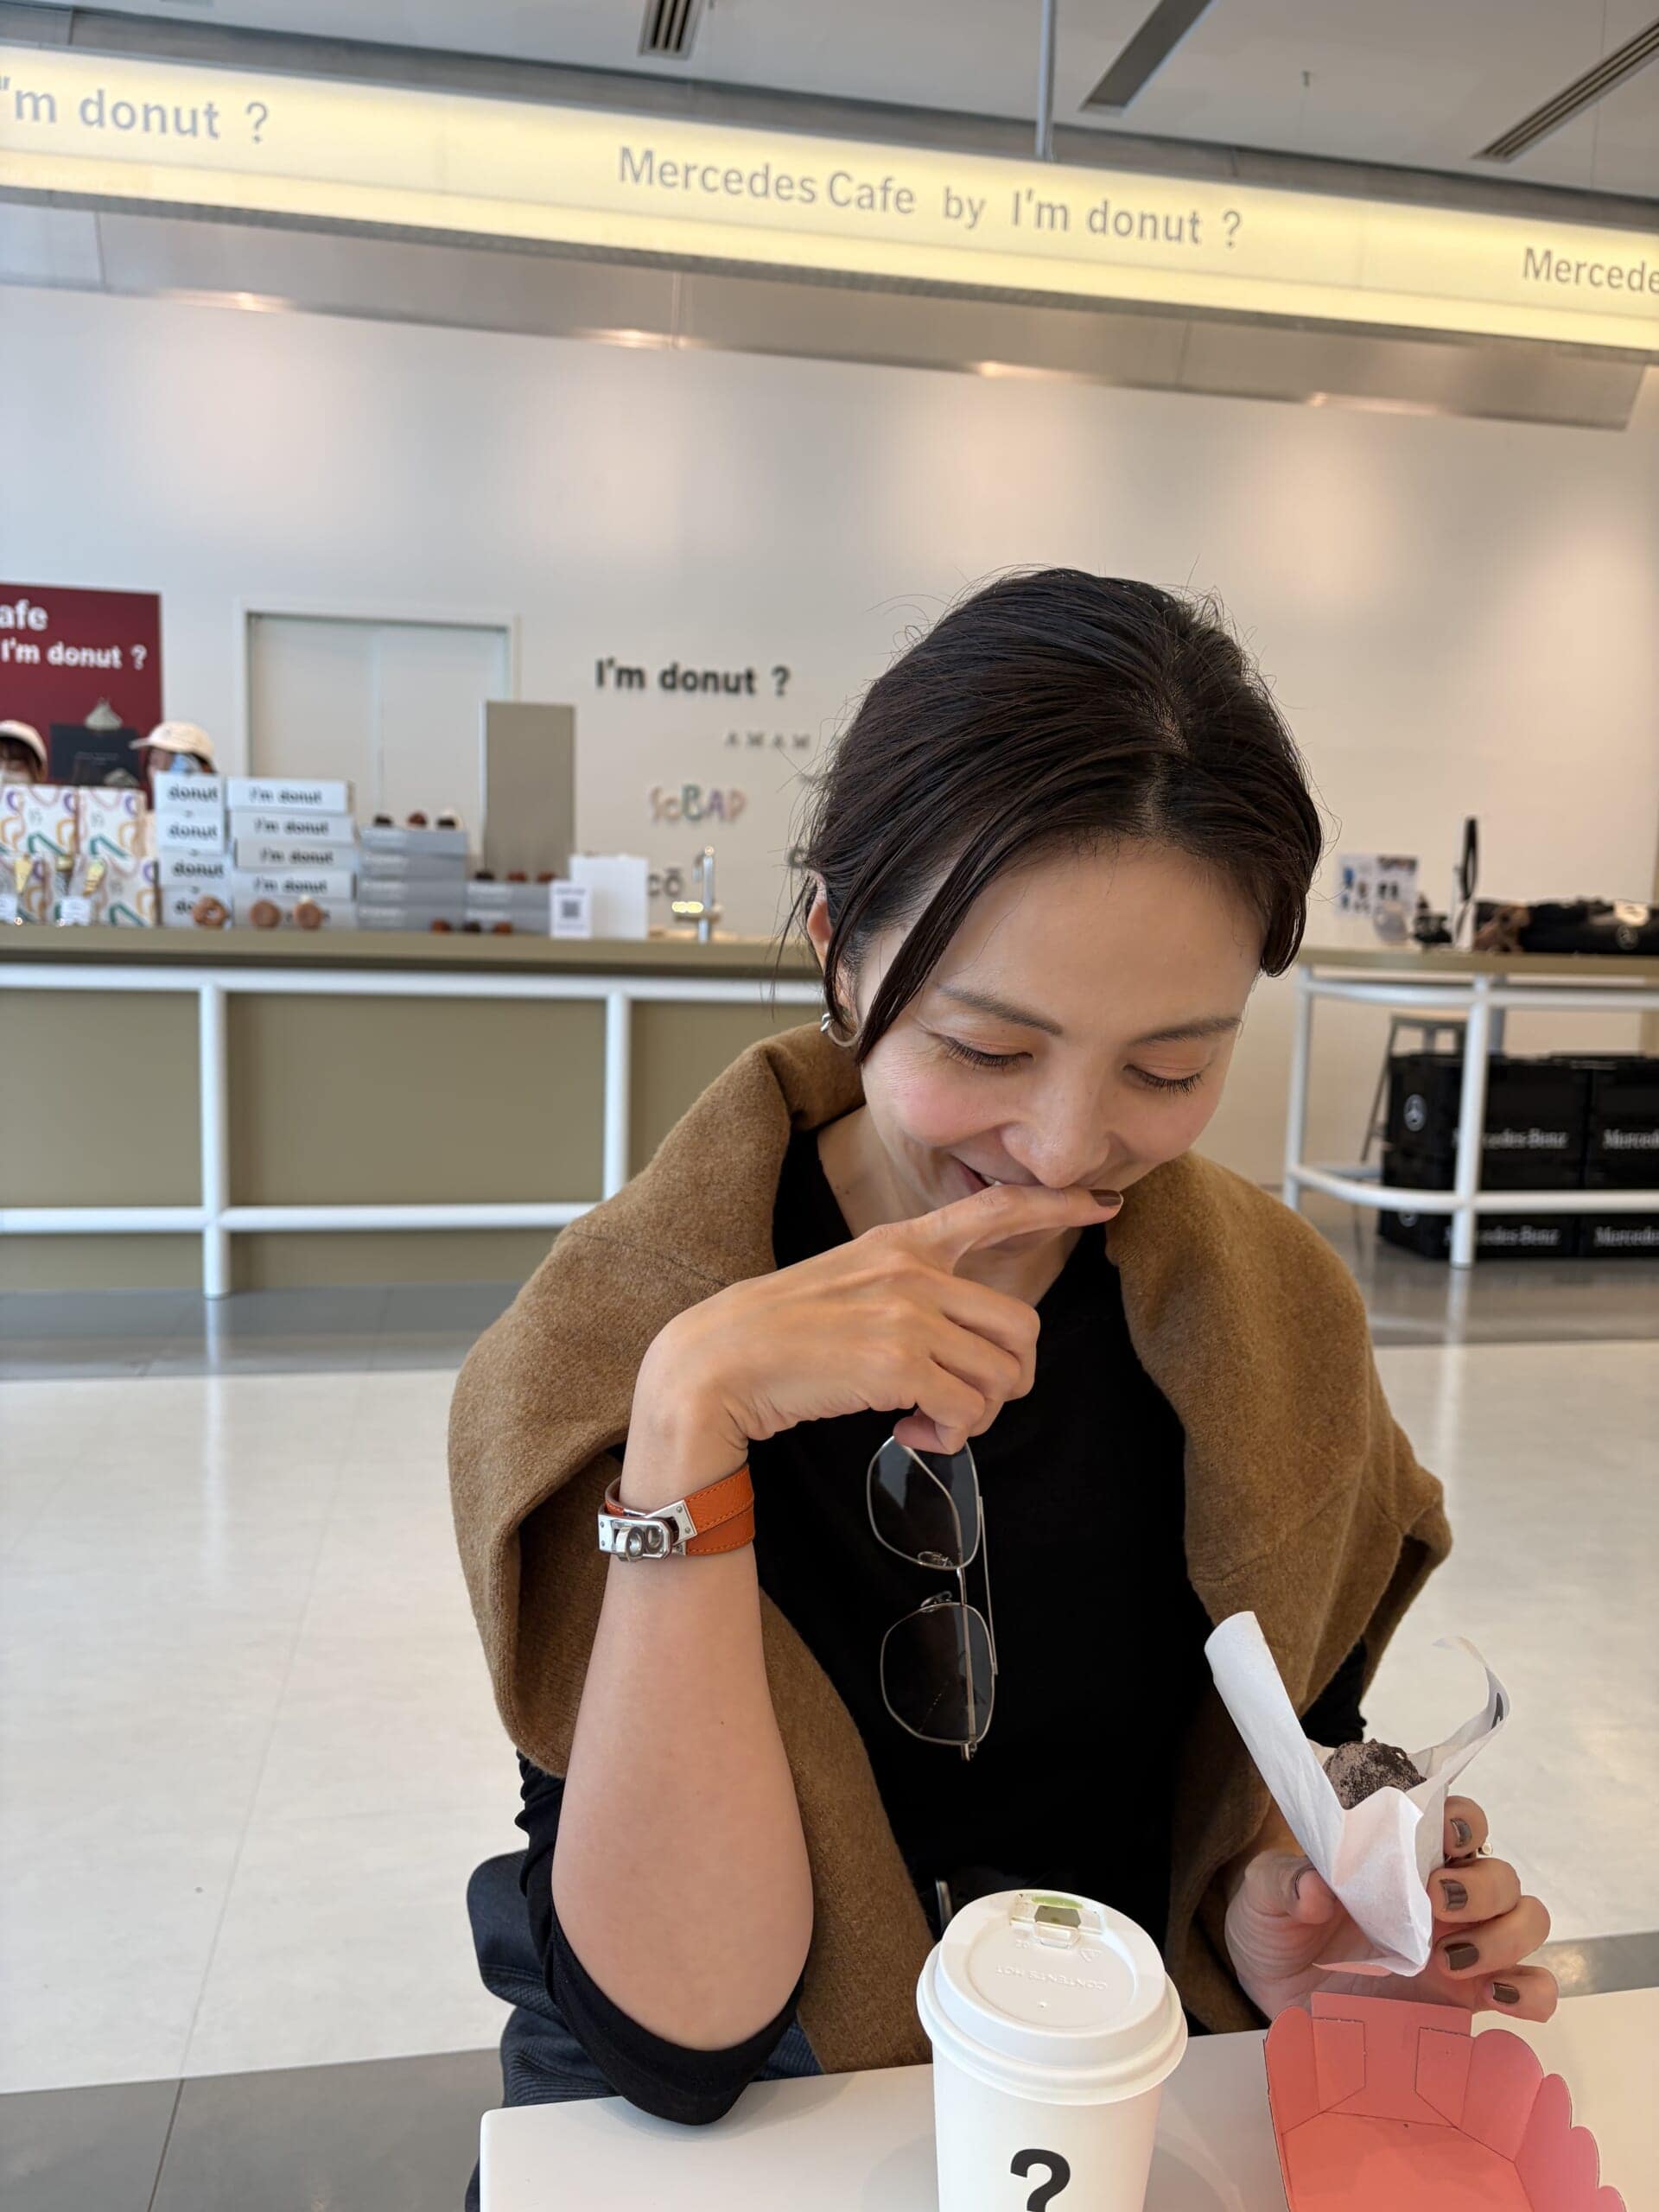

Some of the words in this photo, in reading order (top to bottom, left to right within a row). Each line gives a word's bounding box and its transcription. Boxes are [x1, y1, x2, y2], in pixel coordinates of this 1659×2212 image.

[0, 76, 56, 123] 'm
[79, 89, 219, 139] donut
[245, 101, 268, 143] ?
[620, 146, 816, 204] Mercedes
[828, 173, 915, 214] Cafe
[944, 188, 986, 228] by
[1013, 188, 1069, 231] I'm
[1089, 200, 1200, 245] donut
[1223, 210, 1242, 247] ?
[1523, 247, 1659, 293] Mercede
[1, 638, 41, 664] I'm
[47, 642, 123, 670] donut
[131, 645, 147, 671] ?
[596, 658, 645, 690] I'm
[659, 662, 755, 695] donut
[772, 666, 790, 696] ?
